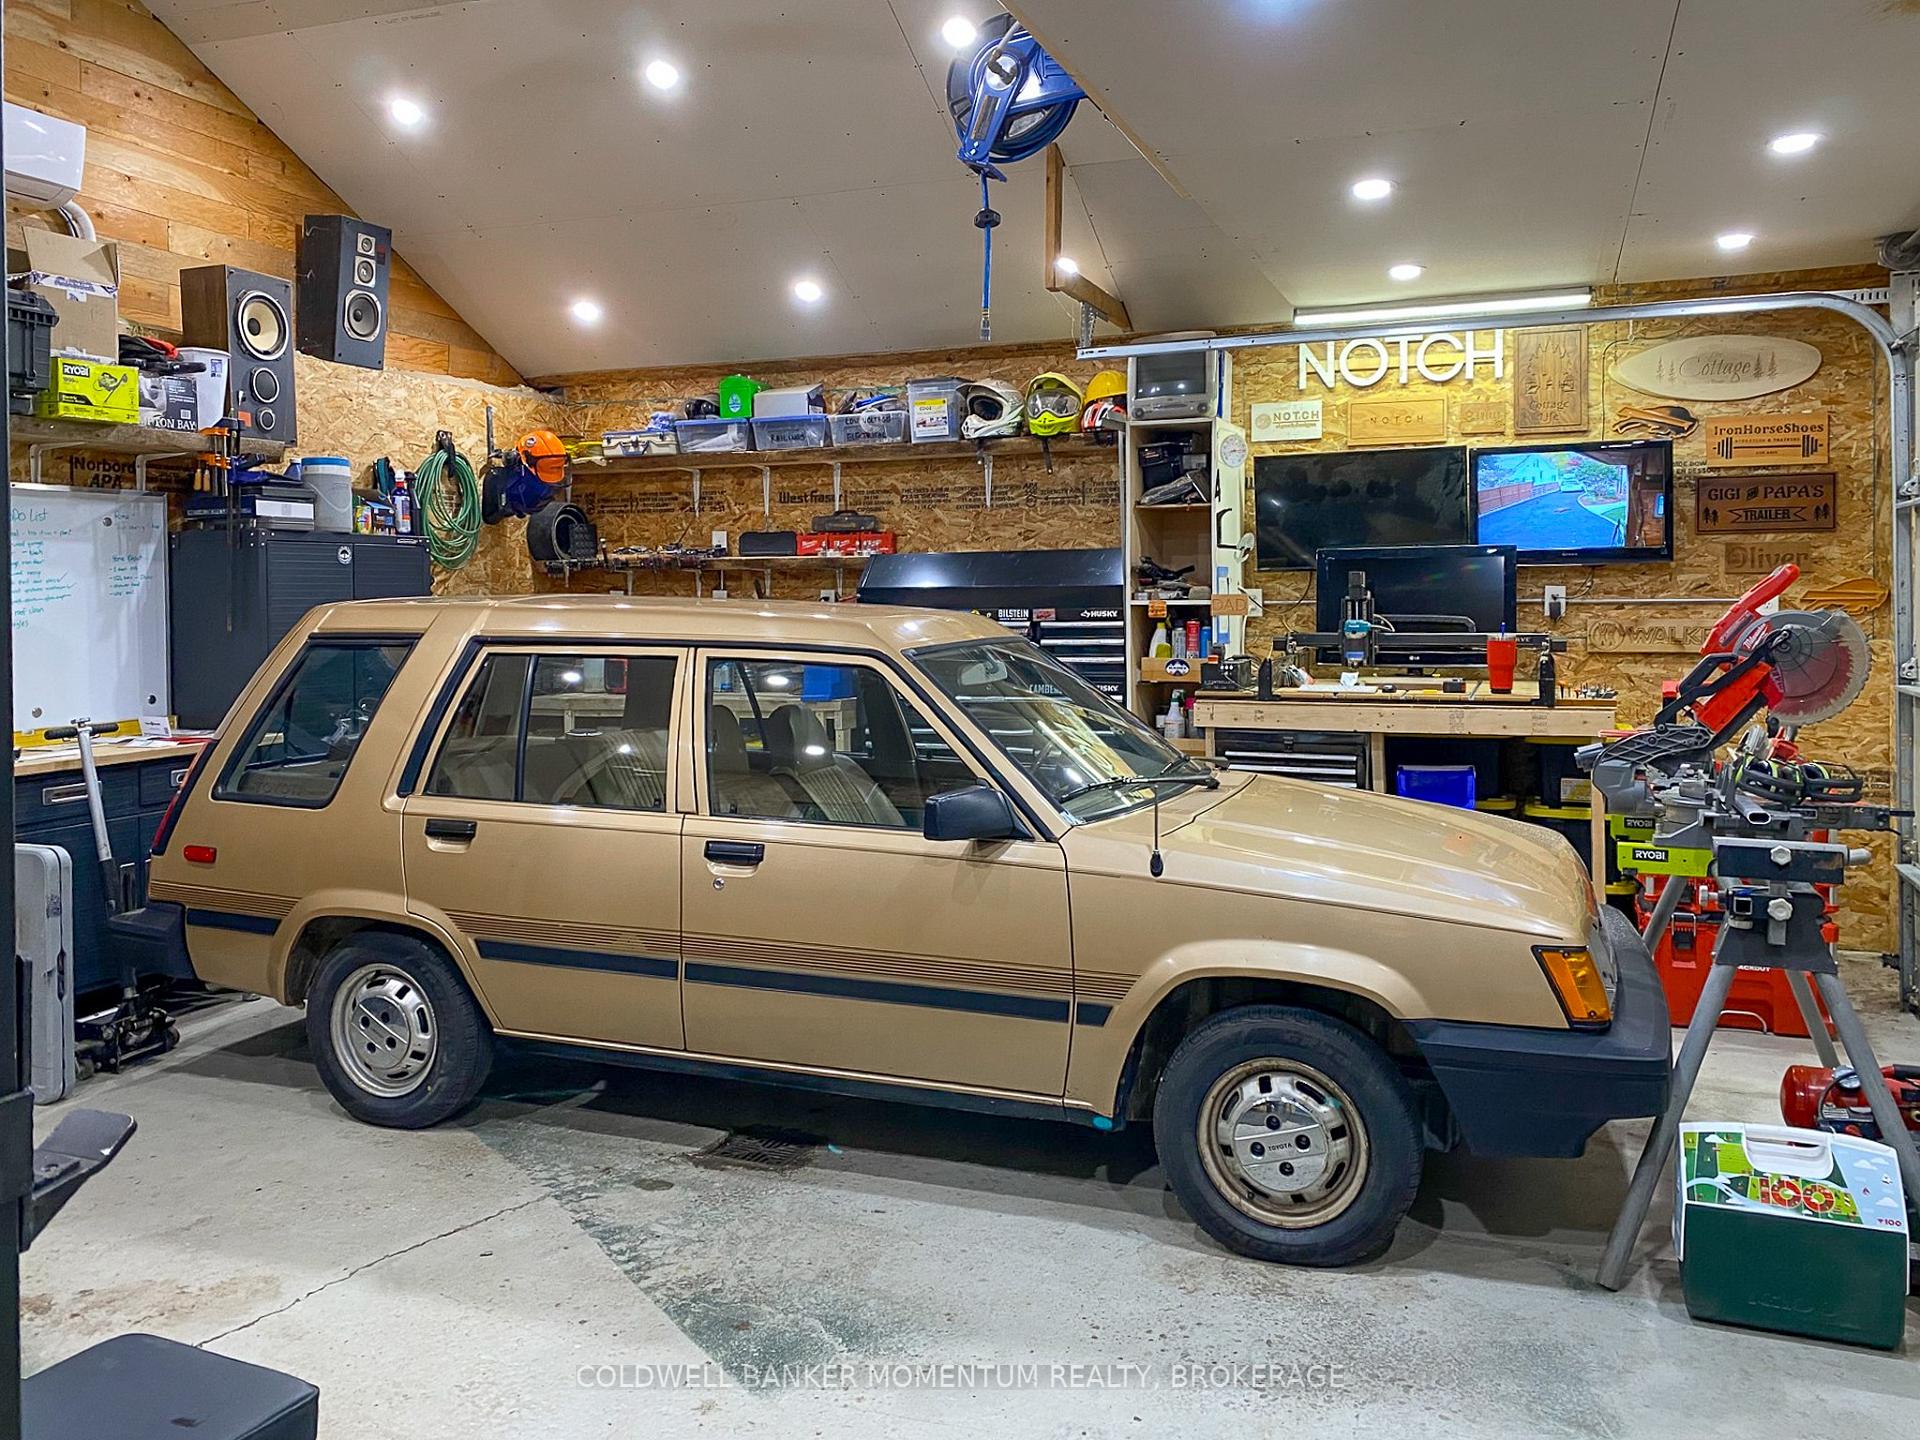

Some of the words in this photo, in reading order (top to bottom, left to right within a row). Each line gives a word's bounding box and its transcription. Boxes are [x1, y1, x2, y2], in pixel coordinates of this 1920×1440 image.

[1298, 329, 1503, 390] NOTCH
[63, 364, 88, 376] RYOBI
[1680, 355, 1751, 383] Cottage
[1273, 410, 1319, 421] NOTCH
[1370, 415, 1424, 424] NOTCH
[177, 419, 196, 431] BAY
[1714, 423, 1824, 436] IronHorseShoes
[74, 457, 136, 474] Norbord
[1708, 487, 1740, 501] GIGI
[1764, 485, 1824, 499] PAPA'S
[1744, 508, 1791, 521] TRAILER
[1726, 546, 1809, 569] Oliver
[1213, 598, 1247, 612] DAD
[998, 609, 1029, 618] BILSTEIN
[1091, 610, 1118, 618] HUSKY
[1626, 819, 1653, 828] RYOBI
[1635, 850, 1665, 860] RYOBI
[1268, 1142, 1292, 1151] TOYOTA
